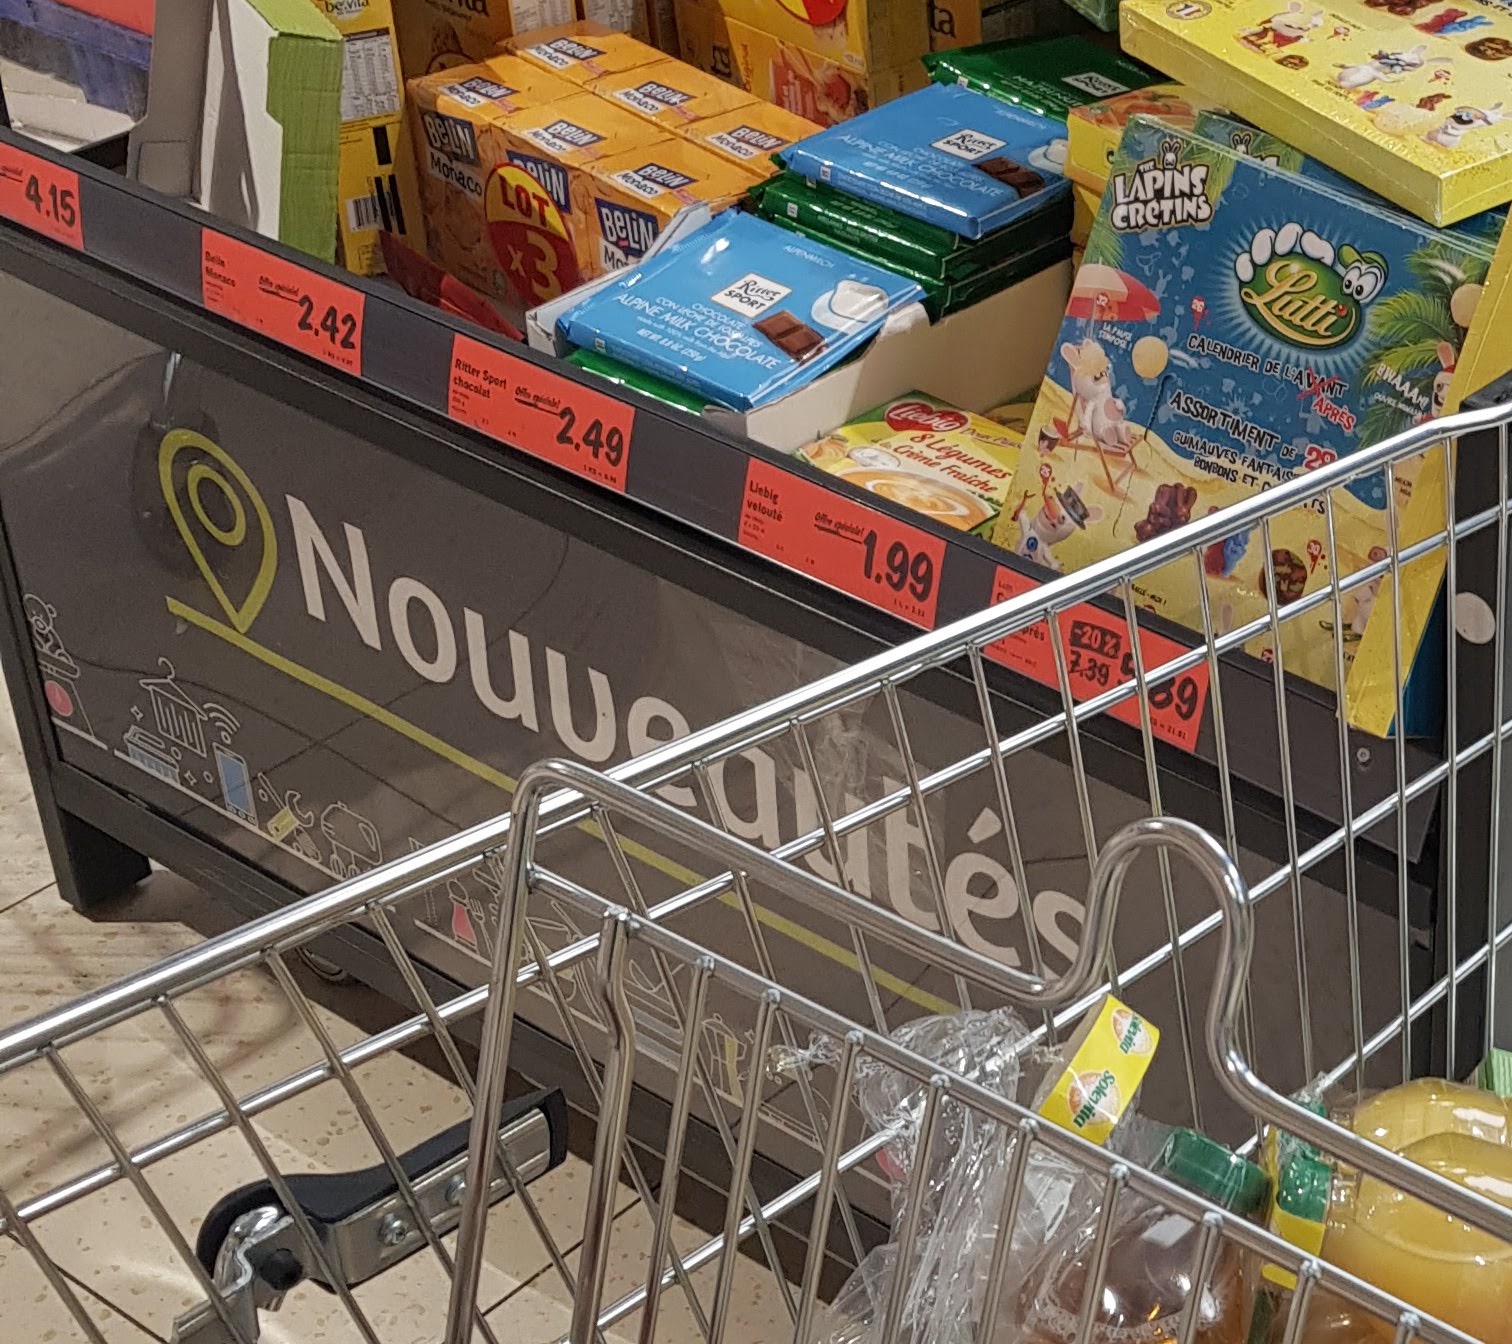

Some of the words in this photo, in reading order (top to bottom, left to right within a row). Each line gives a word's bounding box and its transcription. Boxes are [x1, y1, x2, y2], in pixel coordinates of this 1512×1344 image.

[621, 91, 660, 114] Monaco
[713, 133, 754, 156] Monaco
[942, 138, 984, 156] SPORT
[430, 151, 484, 197] Monaco
[620, 173, 660, 197] Monaco
[917, 163, 1005, 199] CHOCOLATE
[1112, 163, 1211, 205] LAPINS
[1138, 161, 1157, 174] THE
[24, 173, 76, 229] 4.15
[500, 178, 551, 229] LOT
[655, 296, 675, 311] CON
[723, 289, 767, 311] SPORT
[737, 279, 783, 301] Ritter
[1240, 258, 1360, 348] Lutti
[297, 293, 357, 351] 2.42
[613, 292, 665, 319] ALPINE
[659, 312, 693, 332] MILK
[693, 327, 783, 371] CHOCOLATE
[691, 302, 747, 330] CHOCOLATE
[1187, 333, 1261, 370] CALENDRIER
[1263, 360, 1280, 375] DE
[452, 374, 491, 400] chocolat
[454, 357, 482, 379] Ritter
[482, 369, 508, 390] Sport
[889, 406, 961, 432] Liebig
[1169, 390, 1281, 451] ASSORTIMENT
[1280, 445, 1298, 460] DE
[1311, 396, 1357, 433] APRÈS
[556, 406, 624, 468] 2.49
[1172, 430, 1239, 466] GUIMAUVES
[893, 444, 942, 469] Crème
[939, 464, 999, 494] Fraîche
[910, 433, 935, 444] 8
[925, 437, 1013, 480] Légumes
[1192, 455, 1238, 483] BONBONS
[1241, 474, 1257, 488] ET
[746, 498, 784, 523] velouté
[749, 479, 780, 506] Liebig
[813, 511, 833, 527] Offre
[863, 528, 934, 603] 1.99
[1069, 649, 1112, 687] 7.39
